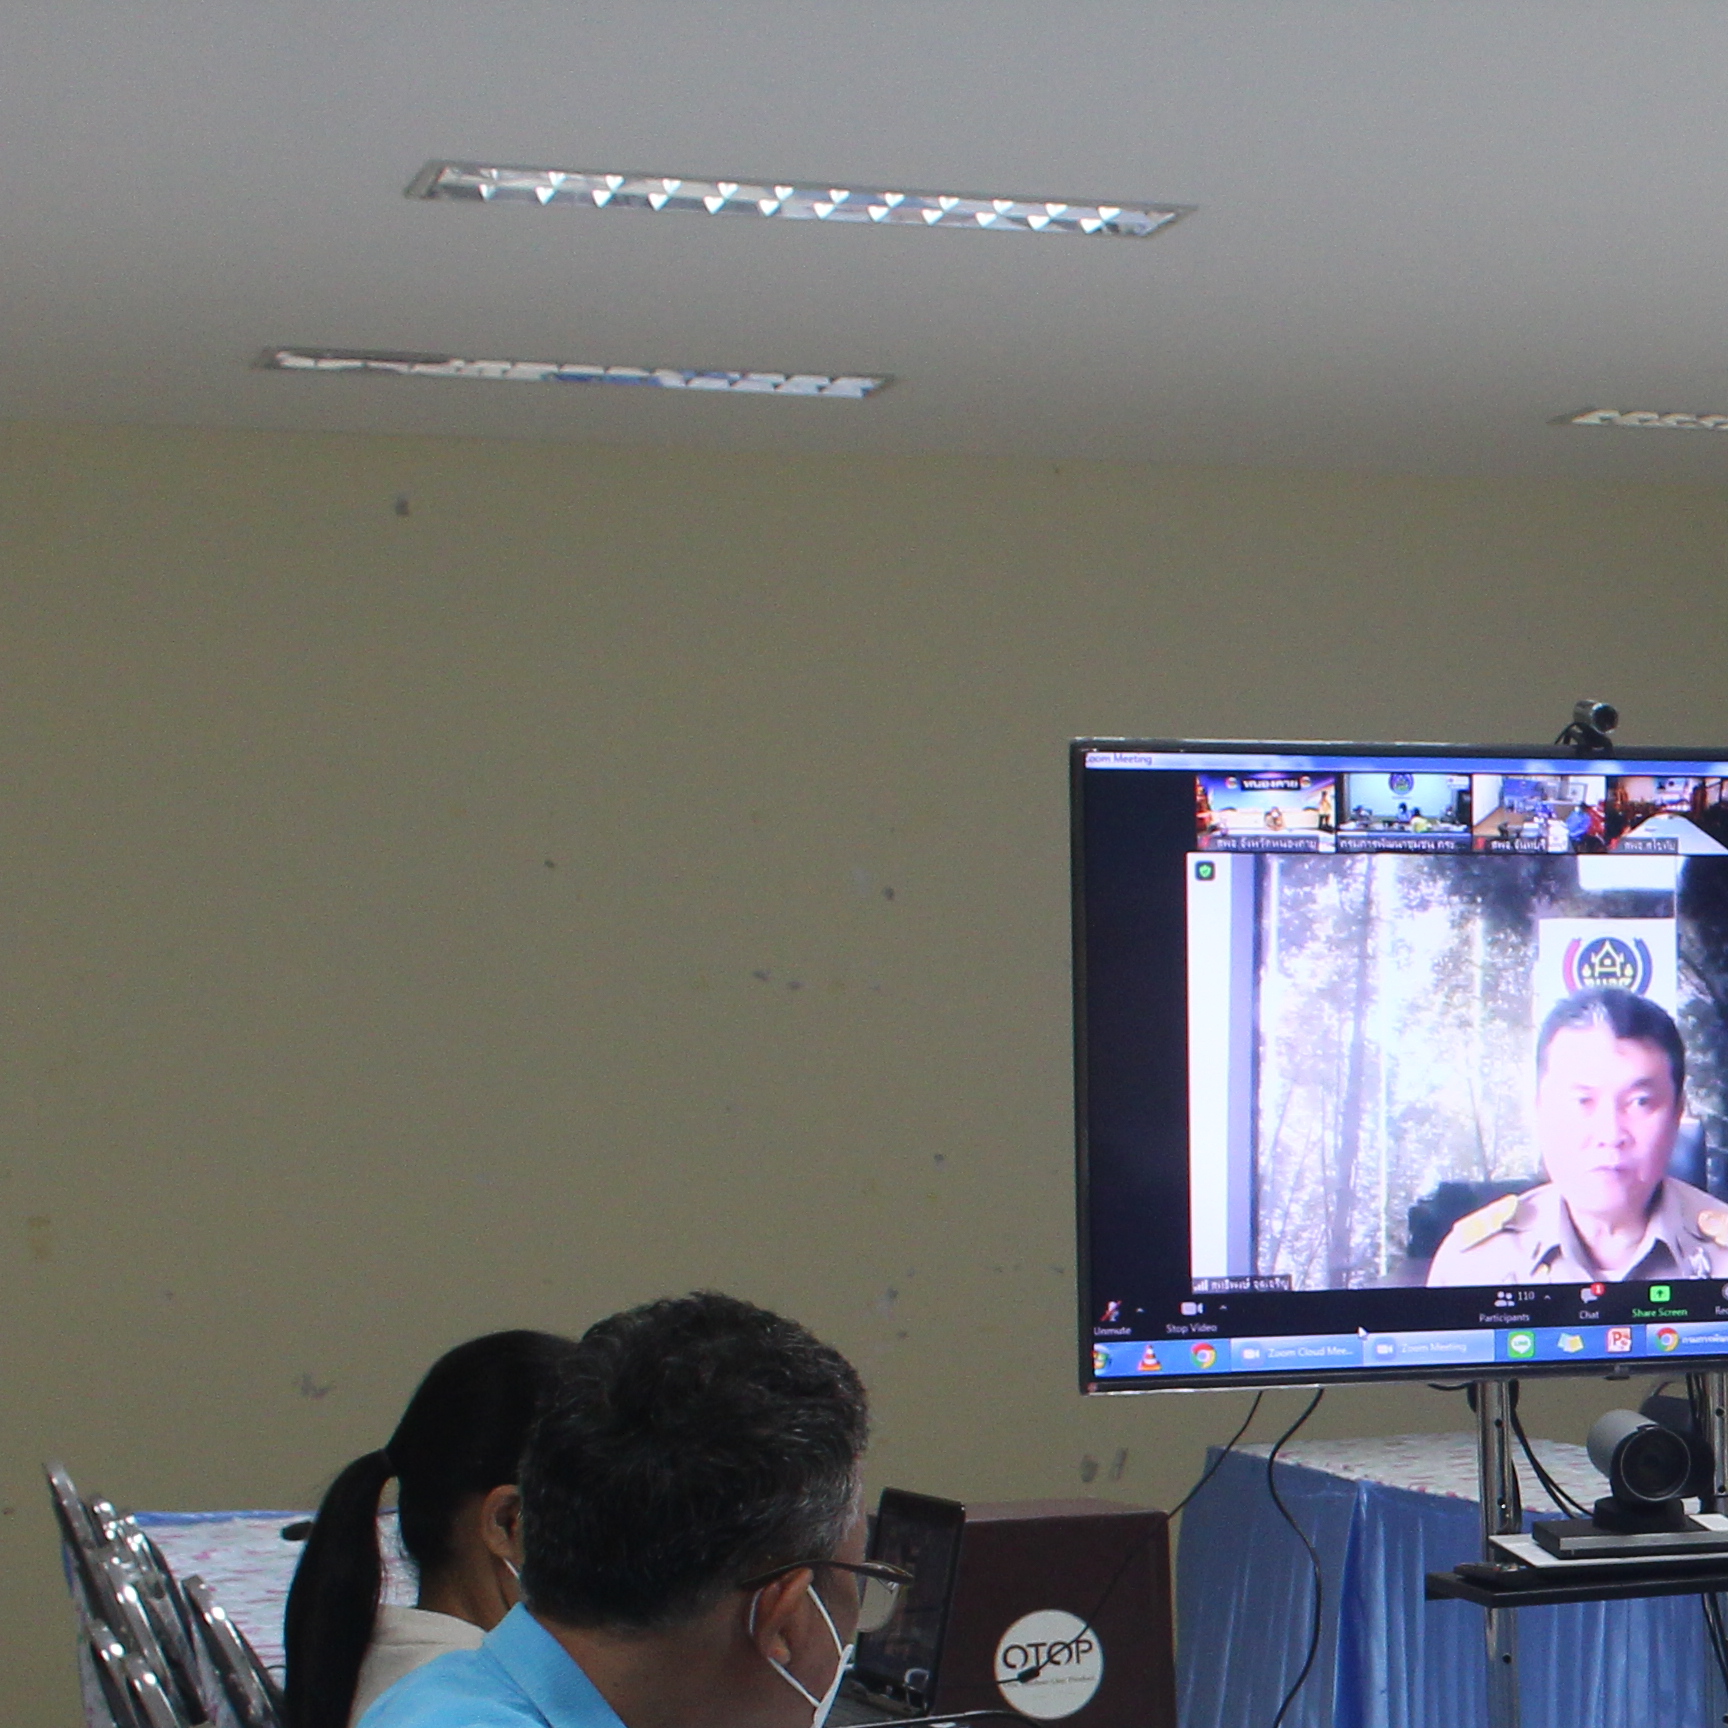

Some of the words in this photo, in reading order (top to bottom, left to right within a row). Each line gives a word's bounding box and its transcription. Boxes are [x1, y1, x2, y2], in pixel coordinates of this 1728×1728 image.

[1113, 754, 1153, 765] Meeting
[1517, 1291, 1535, 1301] 110
[1579, 1310, 1600, 1320] Chat
[1632, 1308, 1657, 1318] Share
[1658, 1307, 1688, 1317] Screen
[1479, 1313, 1530, 1324] Participants
[1093, 1326, 1132, 1336] Unmute
[1166, 1324, 1188, 1335] Stop
[1189, 1323, 1218, 1333] Video
[1268, 1347, 1295, 1358] Zoom
[1297, 1346, 1326, 1357] Cloud
[1401, 1343, 1429, 1354] Zoom
[1430, 1341, 1468, 1353] Meeting
[1003, 1639, 1093, 1669] OTOP
